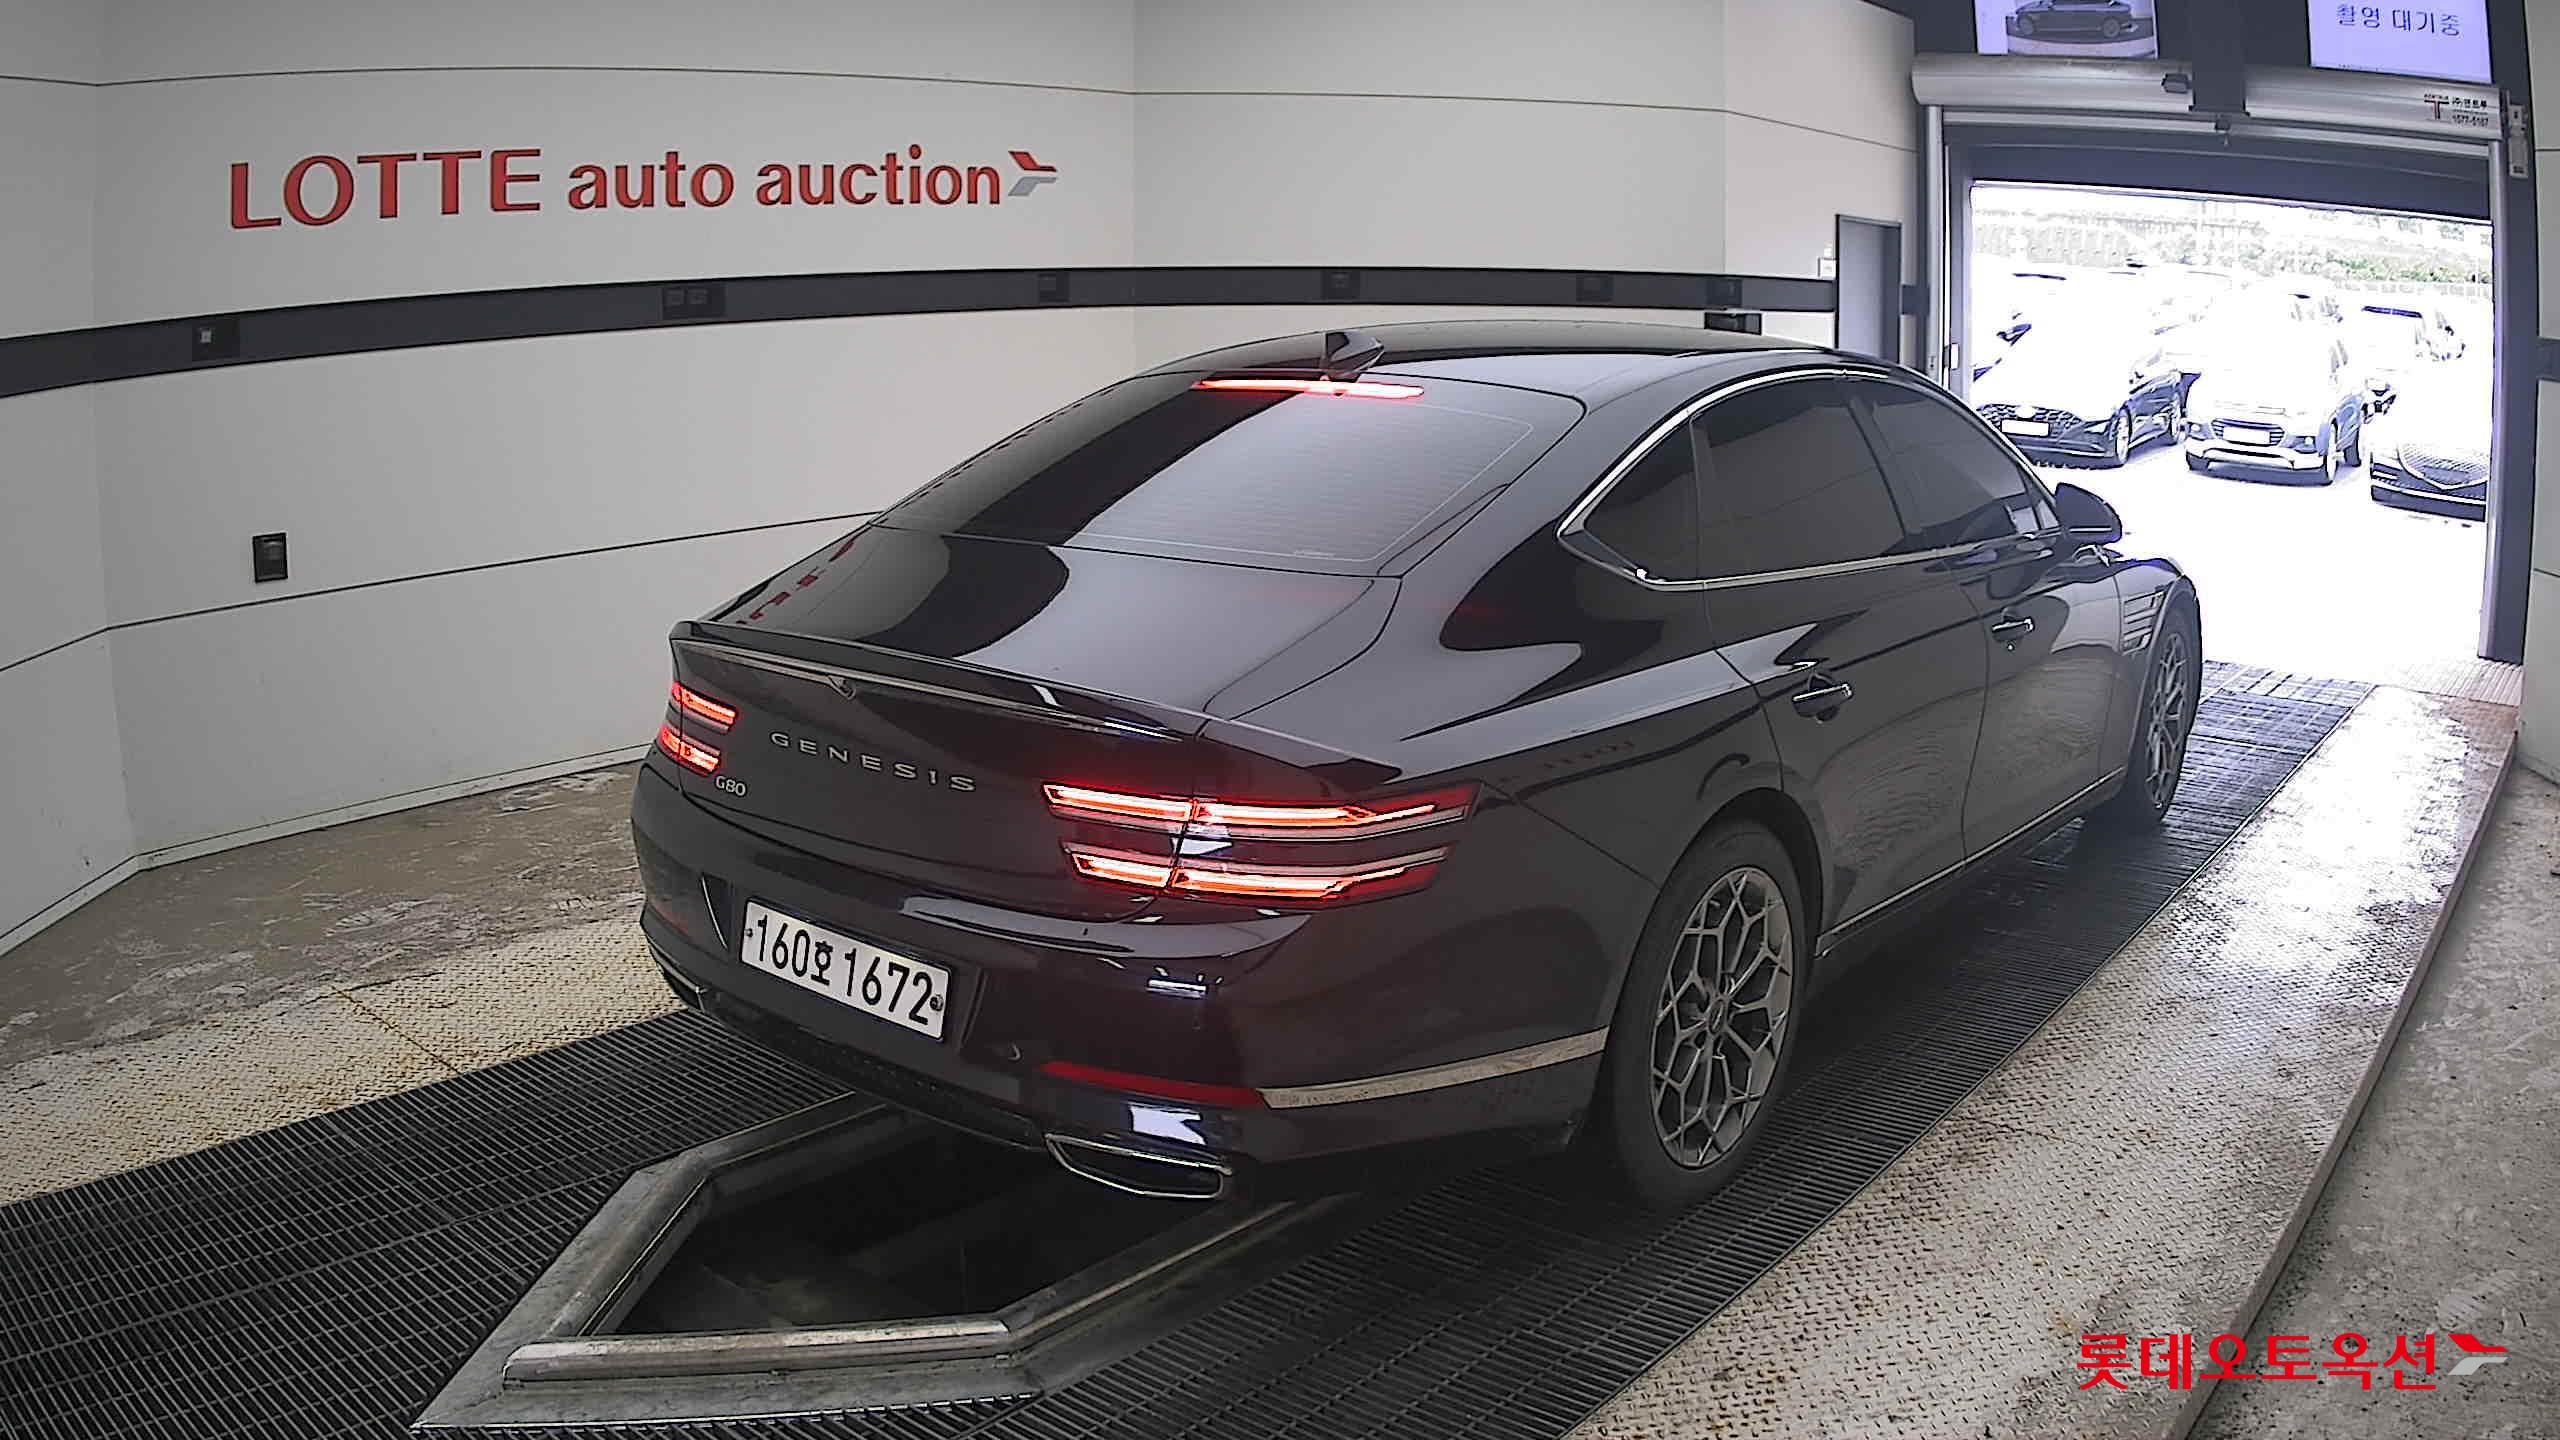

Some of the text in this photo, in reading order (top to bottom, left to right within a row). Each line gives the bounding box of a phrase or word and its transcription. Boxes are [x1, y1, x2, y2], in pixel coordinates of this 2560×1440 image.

[2336, 3, 2461, 37] 촬영 대기중
[229, 144, 1002, 228] LOTTE auto auction
[714, 774, 747, 798] G80
[770, 731, 976, 793] GENESIS
